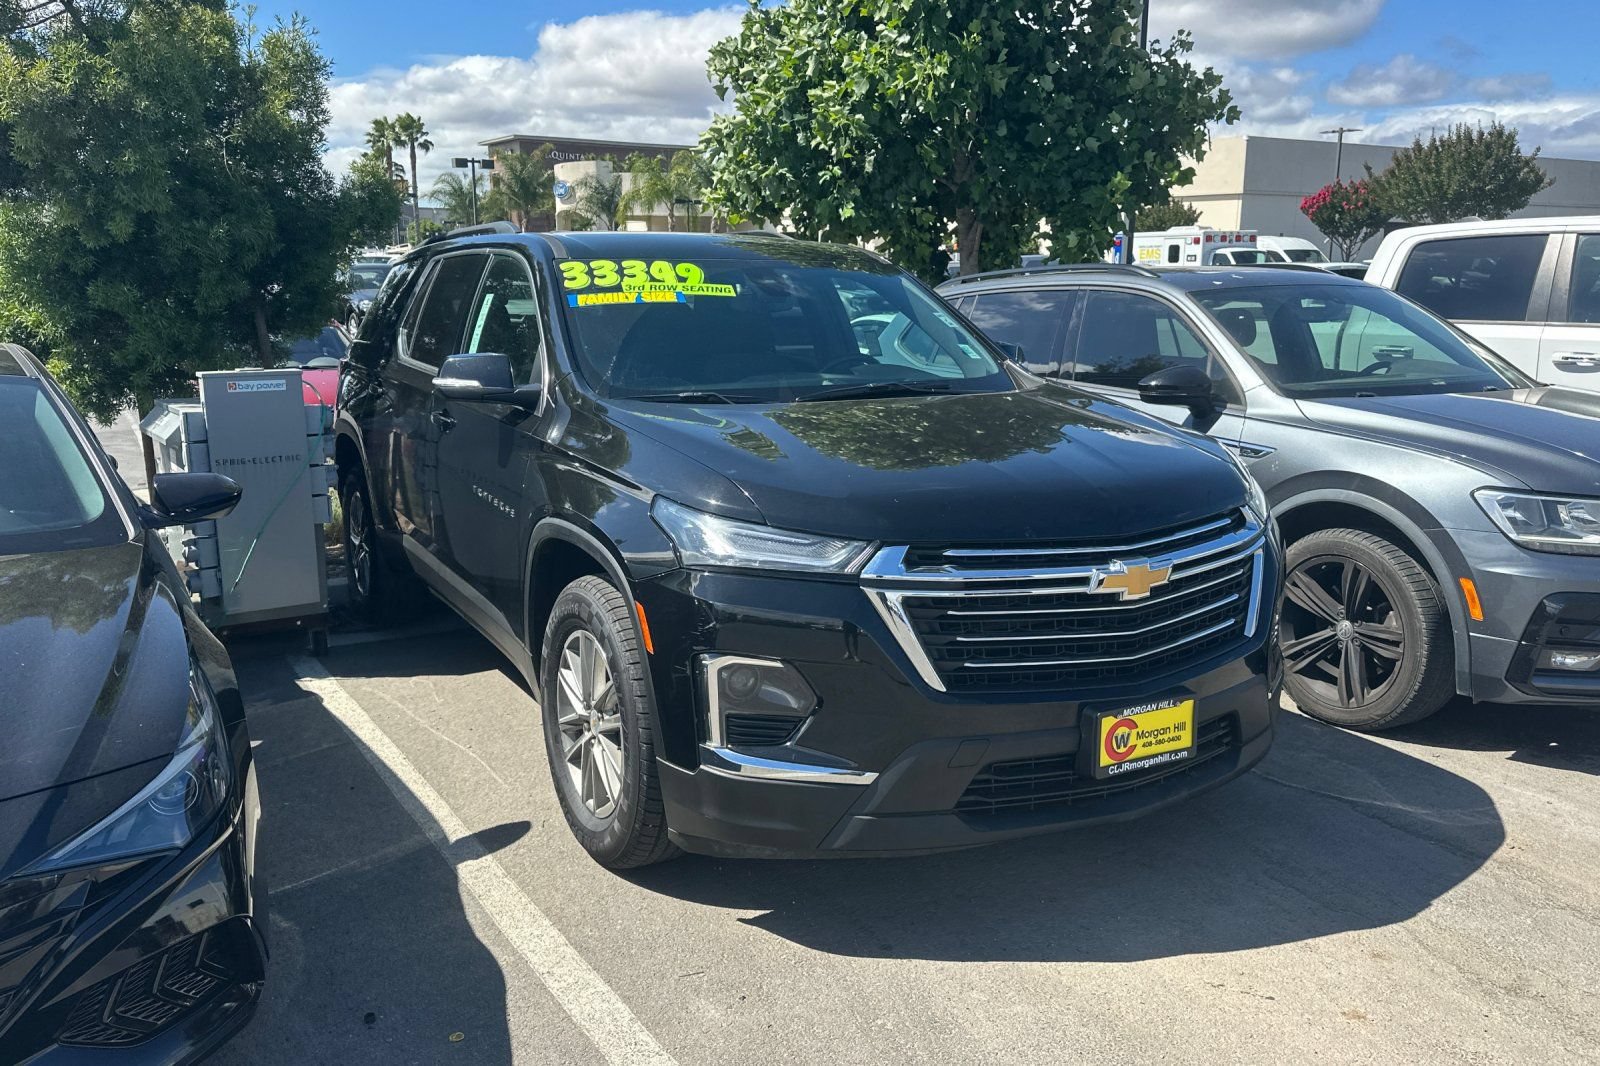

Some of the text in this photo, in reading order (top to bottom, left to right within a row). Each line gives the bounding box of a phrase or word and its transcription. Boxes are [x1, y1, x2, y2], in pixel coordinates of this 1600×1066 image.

[551, 150, 585, 161] QUINTA
[1139, 248, 1161, 260] EMS
[624, 284, 732, 294] 3rd ROW SEATING
[578, 291, 677, 306] FAMILY SIZE
[237, 382, 286, 391] bay power
[1123, 699, 1175, 718] MORGAN HILL
[1136, 721, 1187, 741] Morgan Hill
